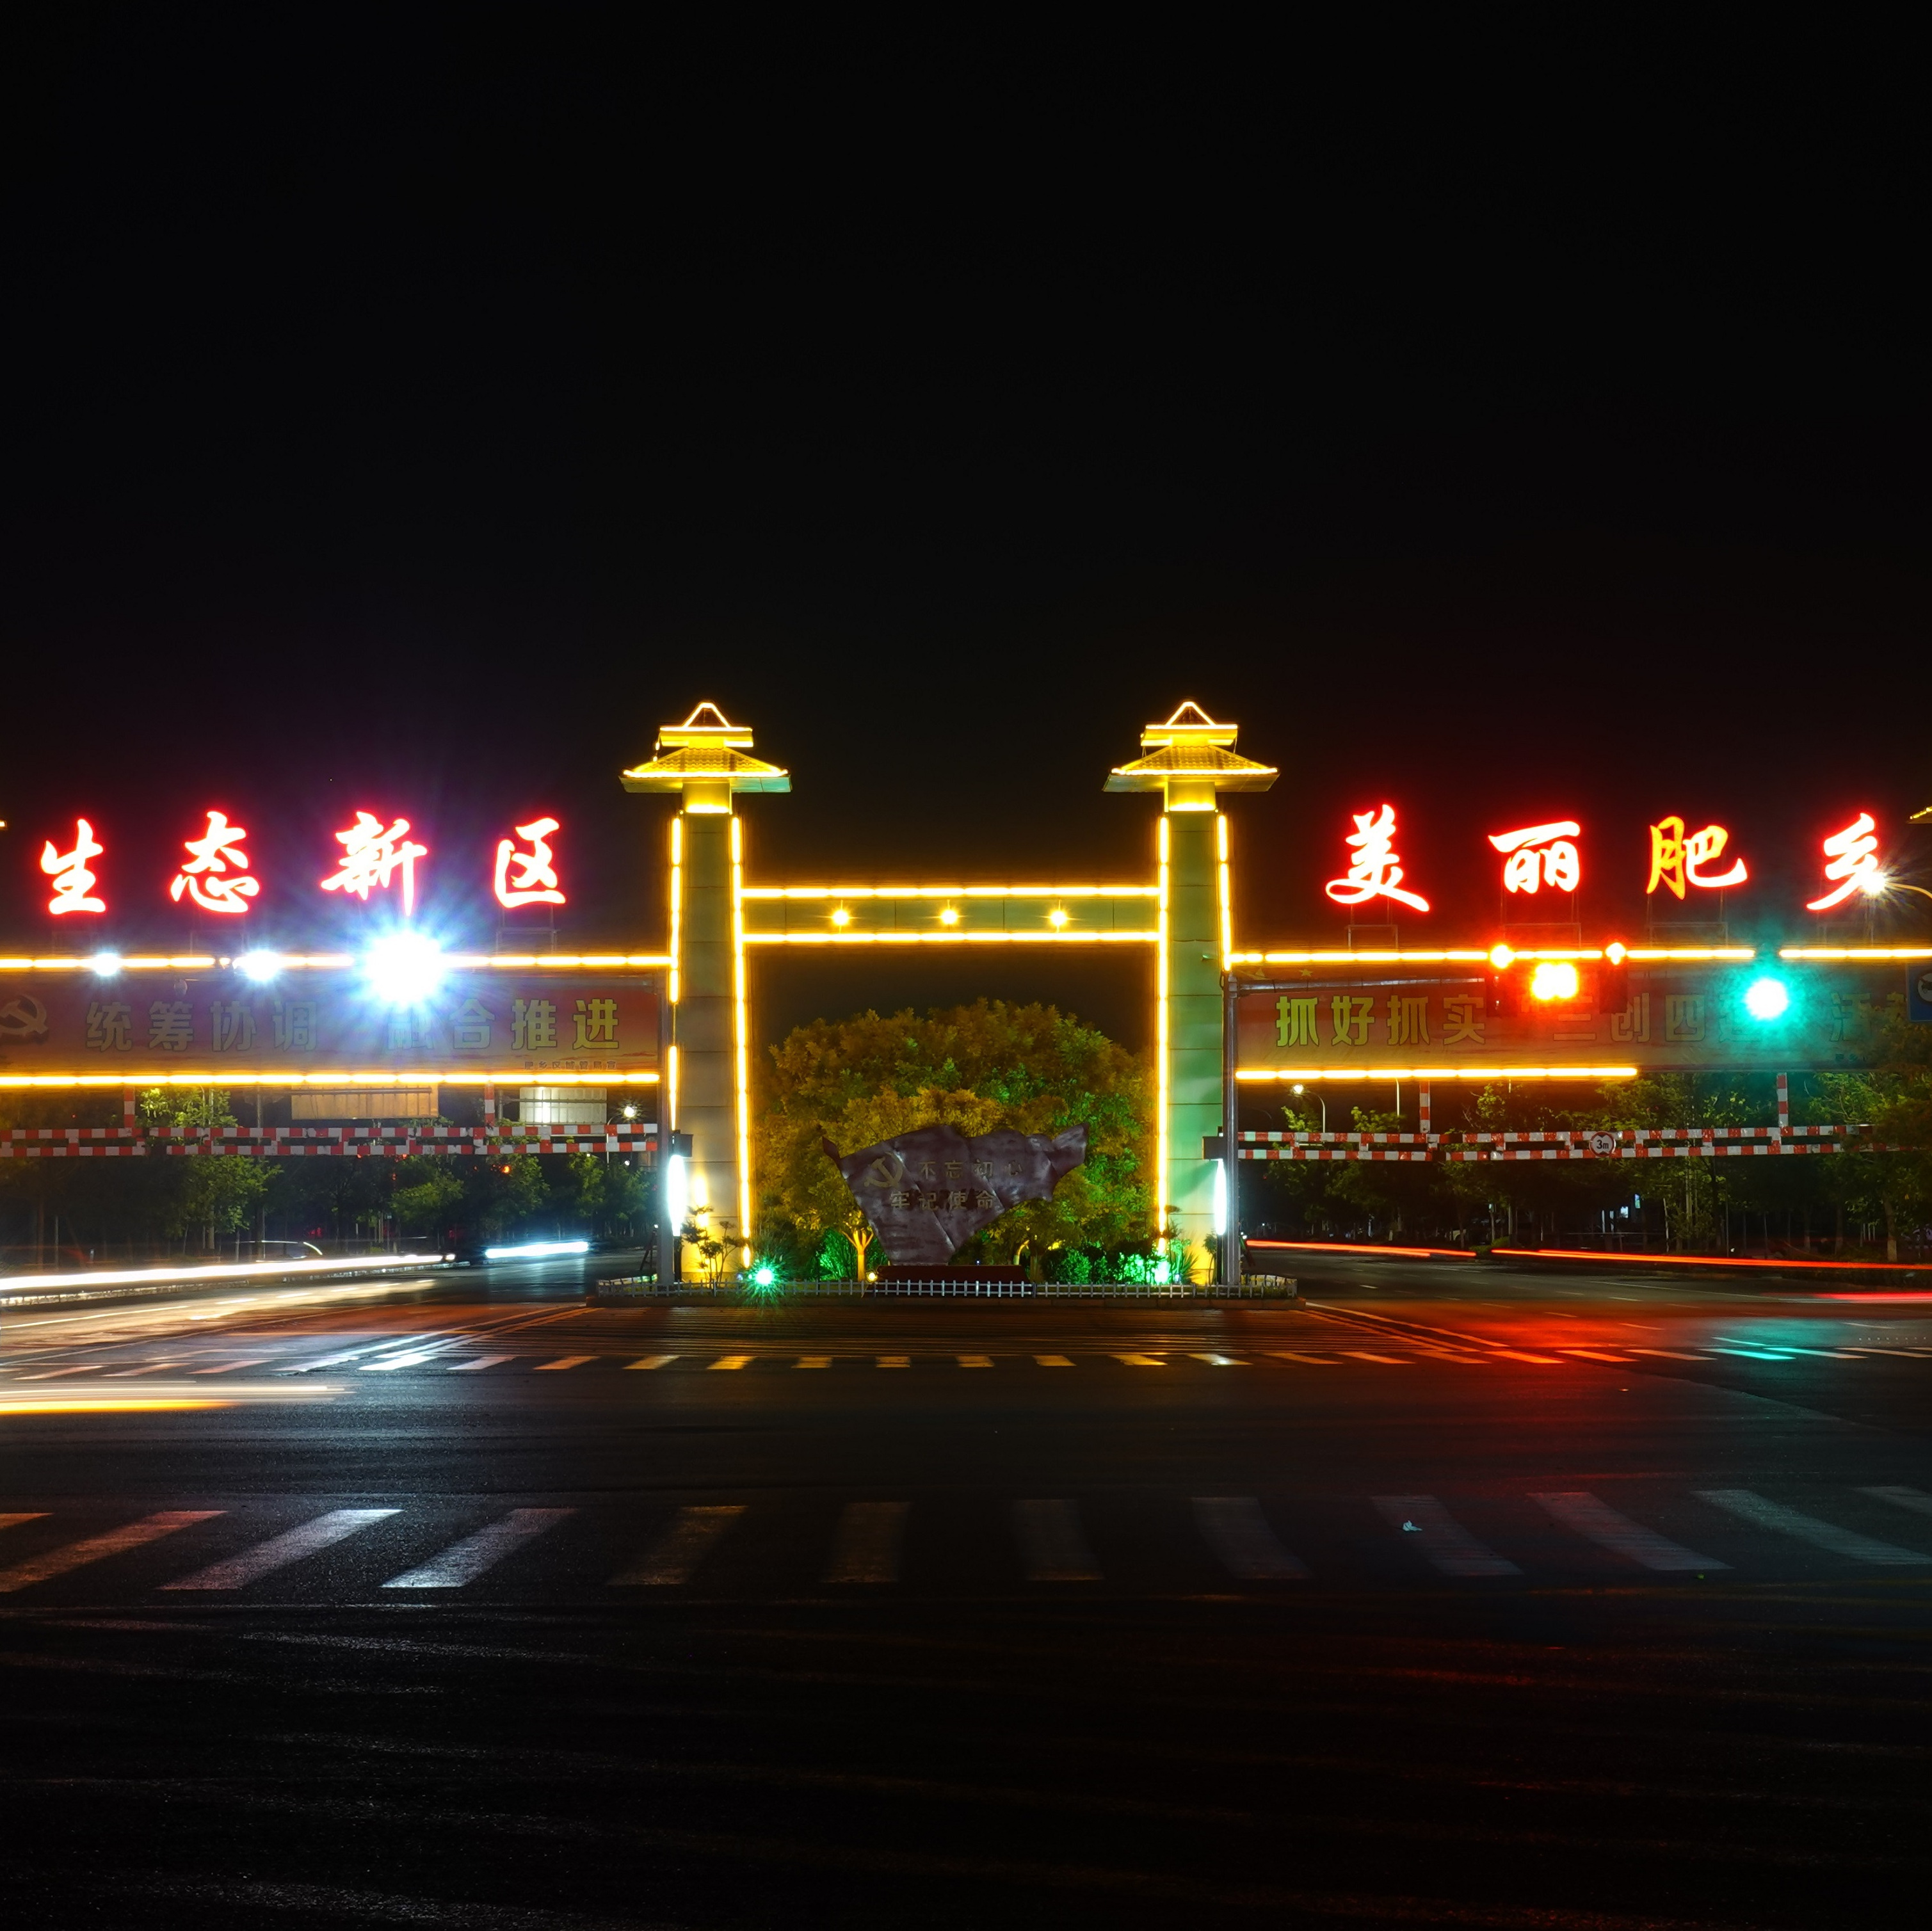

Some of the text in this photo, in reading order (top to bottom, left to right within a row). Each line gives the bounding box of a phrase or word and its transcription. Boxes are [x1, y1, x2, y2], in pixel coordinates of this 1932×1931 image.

[40, 810, 567, 916] 生态新区
[1324, 804, 1880, 912] 美丽肥乡
[85, 999, 319, 1052] 统筹协调
[1596, 1139, 1609, 1150] 3m
[918, 1158, 1024, 1180] 不忘初心
[889, 1189, 996, 1212] 牢记使命
